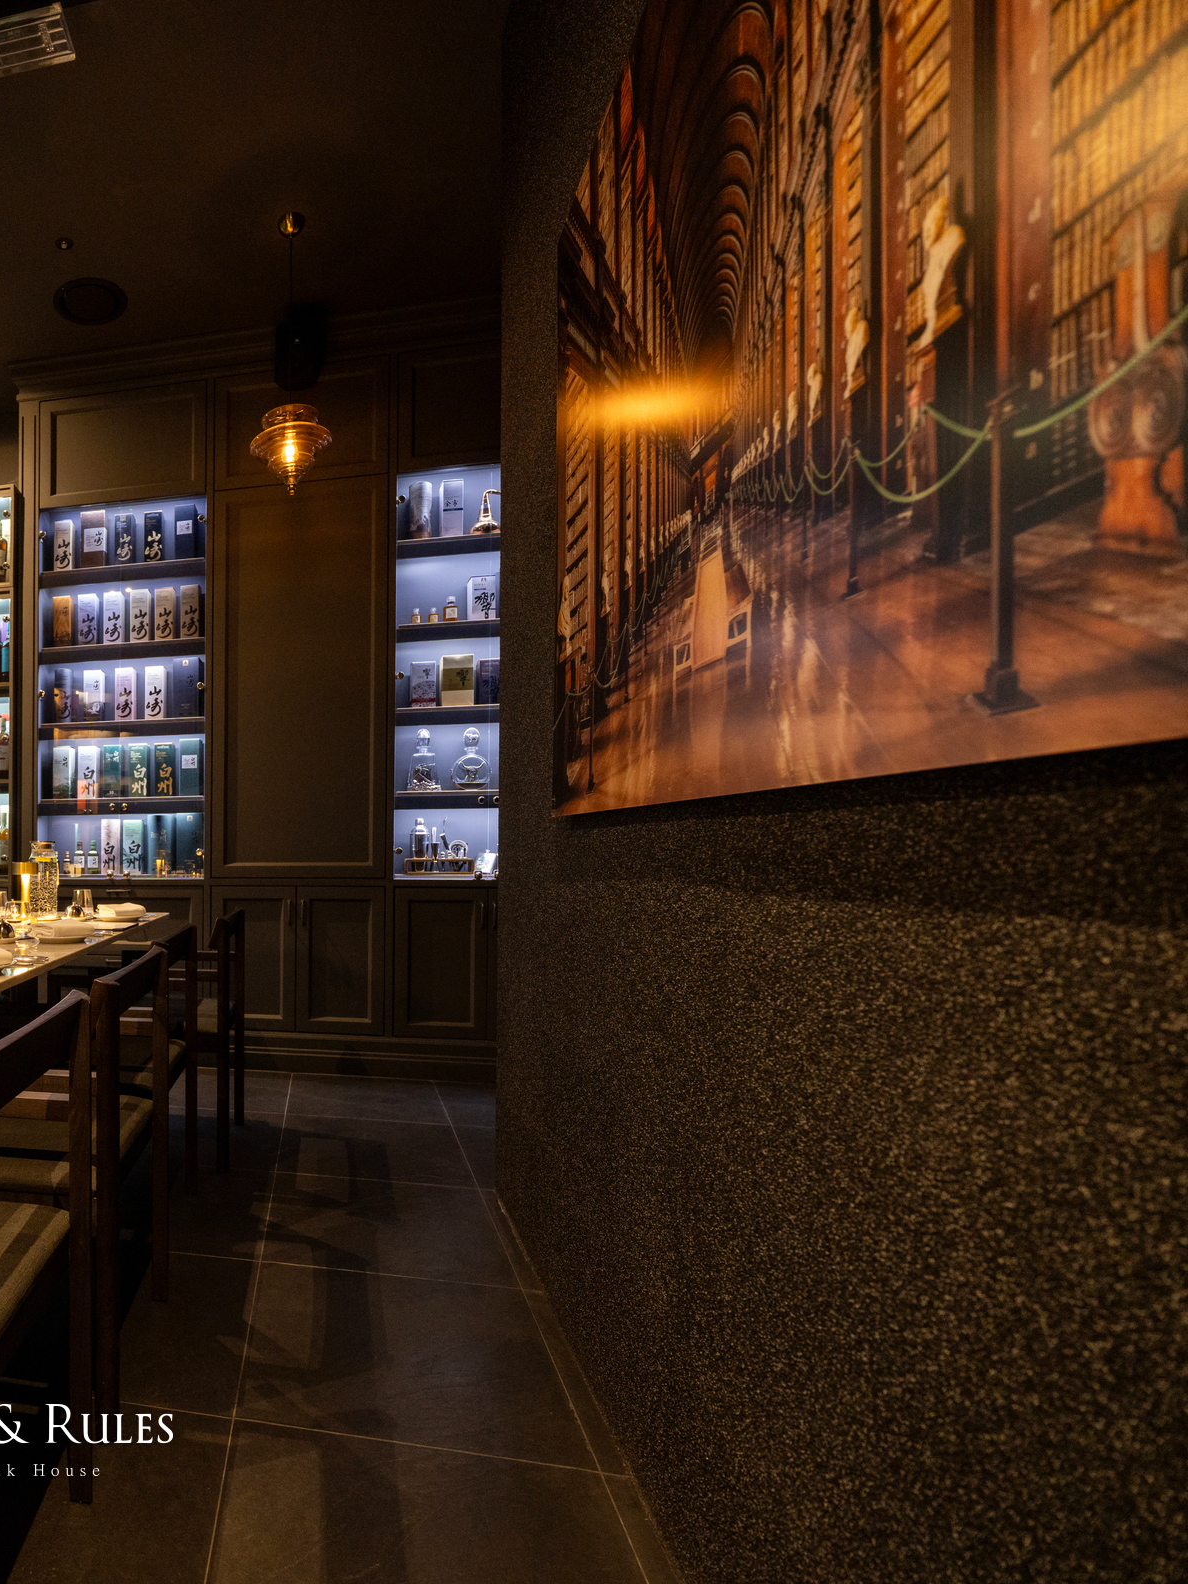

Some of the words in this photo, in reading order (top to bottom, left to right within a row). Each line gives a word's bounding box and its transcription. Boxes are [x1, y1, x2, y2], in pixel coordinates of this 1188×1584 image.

[93, 530, 104, 546] 山崎
[116, 534, 133, 561] 山崎
[144, 530, 162, 562] 山崎
[54, 538, 72, 570] 山崎
[79, 614, 96, 644] 山崎
[105, 612, 121, 642] 山崎
[131, 609, 149, 640] 山崎
[156, 607, 173, 638] 山崎
[182, 605, 199, 636] 山崎
[116, 688, 132, 718] 山崎
[146, 686, 163, 717] 山崎
[81, 766, 96, 797] 白州
[132, 764, 147, 796] 白州
[157, 763, 173, 796] 白州
[102, 842, 115, 871] 白州
[126, 840, 142, 871] 白州
